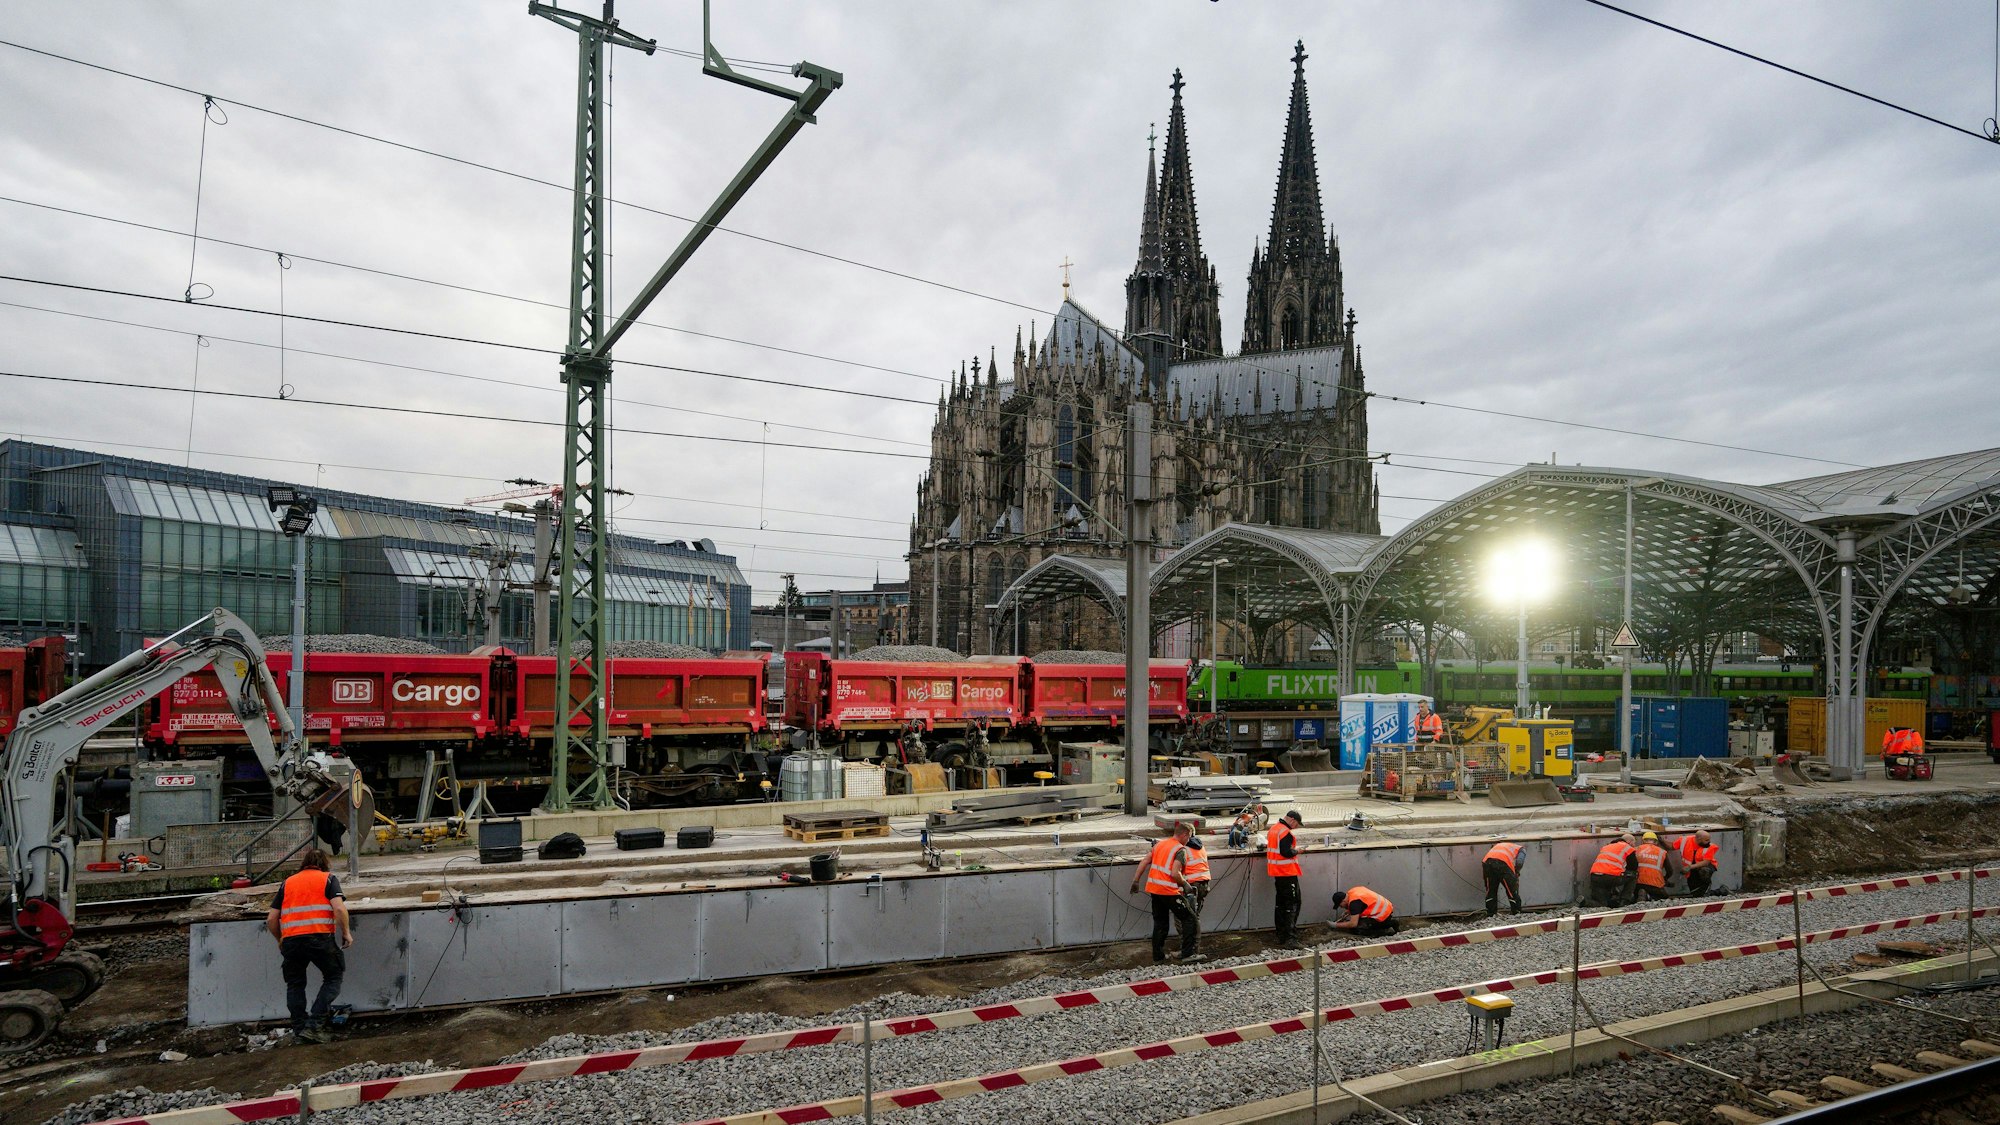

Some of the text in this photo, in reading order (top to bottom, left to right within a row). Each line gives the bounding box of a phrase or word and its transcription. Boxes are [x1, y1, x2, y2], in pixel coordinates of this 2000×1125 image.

[338, 679, 481, 706] DB Cargo
[961, 684, 1004, 700] Cargo
[1267, 675, 1377, 695] FLiXTRIN
[76, 689, 146, 727] TAKEUCHI
